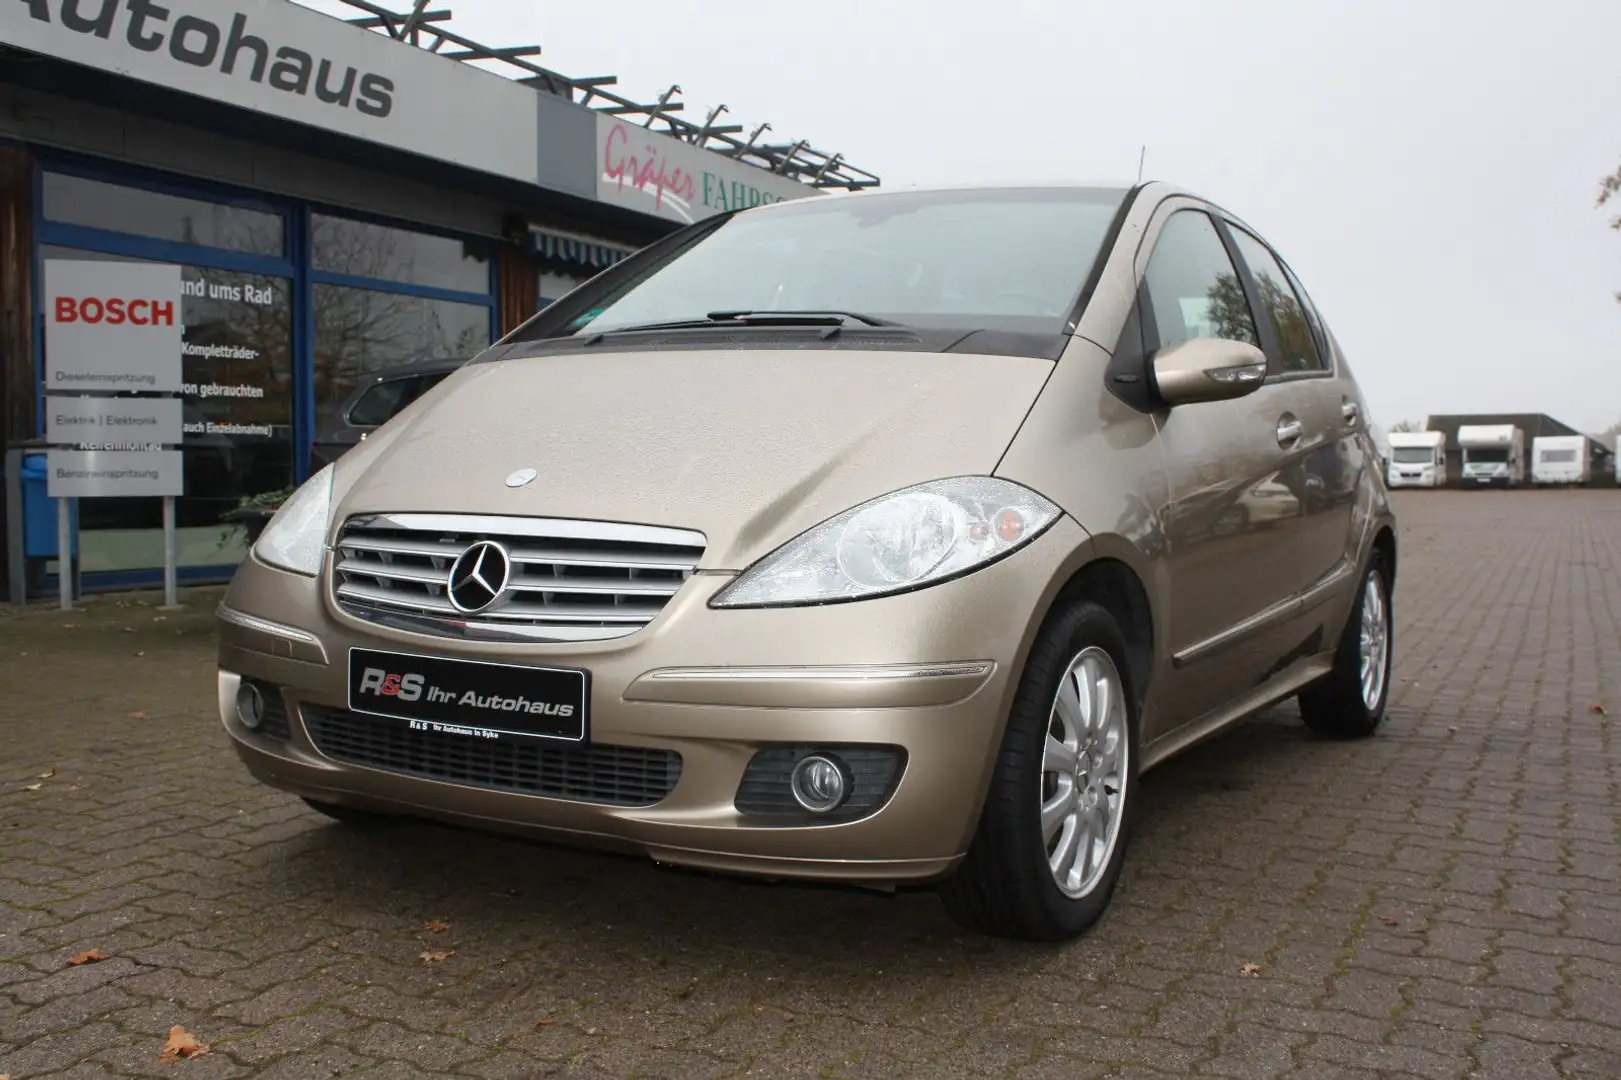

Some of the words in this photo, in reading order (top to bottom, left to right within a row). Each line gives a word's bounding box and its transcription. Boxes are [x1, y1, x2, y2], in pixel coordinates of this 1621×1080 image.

[605, 123, 696, 211] Gräper
[209, 283, 241, 301] ums
[244, 284, 272, 305] Rad
[55, 296, 174, 326] BOSCH
[181, 342, 260, 360] Kompletträder-
[55, 371, 156, 385] Dieseleinspritzung
[200, 382, 264, 398] gebrauchten
[55, 414, 96, 426] Elektrik
[106, 414, 158, 426] Elektronik
[183, 421, 205, 432] auch
[56, 468, 159, 480] Benzineinspritzung
[426, 686, 456, 705] Ihr
[458, 690, 575, 718] Autohaus
[433, 723, 442, 731] Ihr
[443, 725, 473, 736] Autohaus
[474, 729, 481, 737] in
[482, 730, 499, 739] Syke
